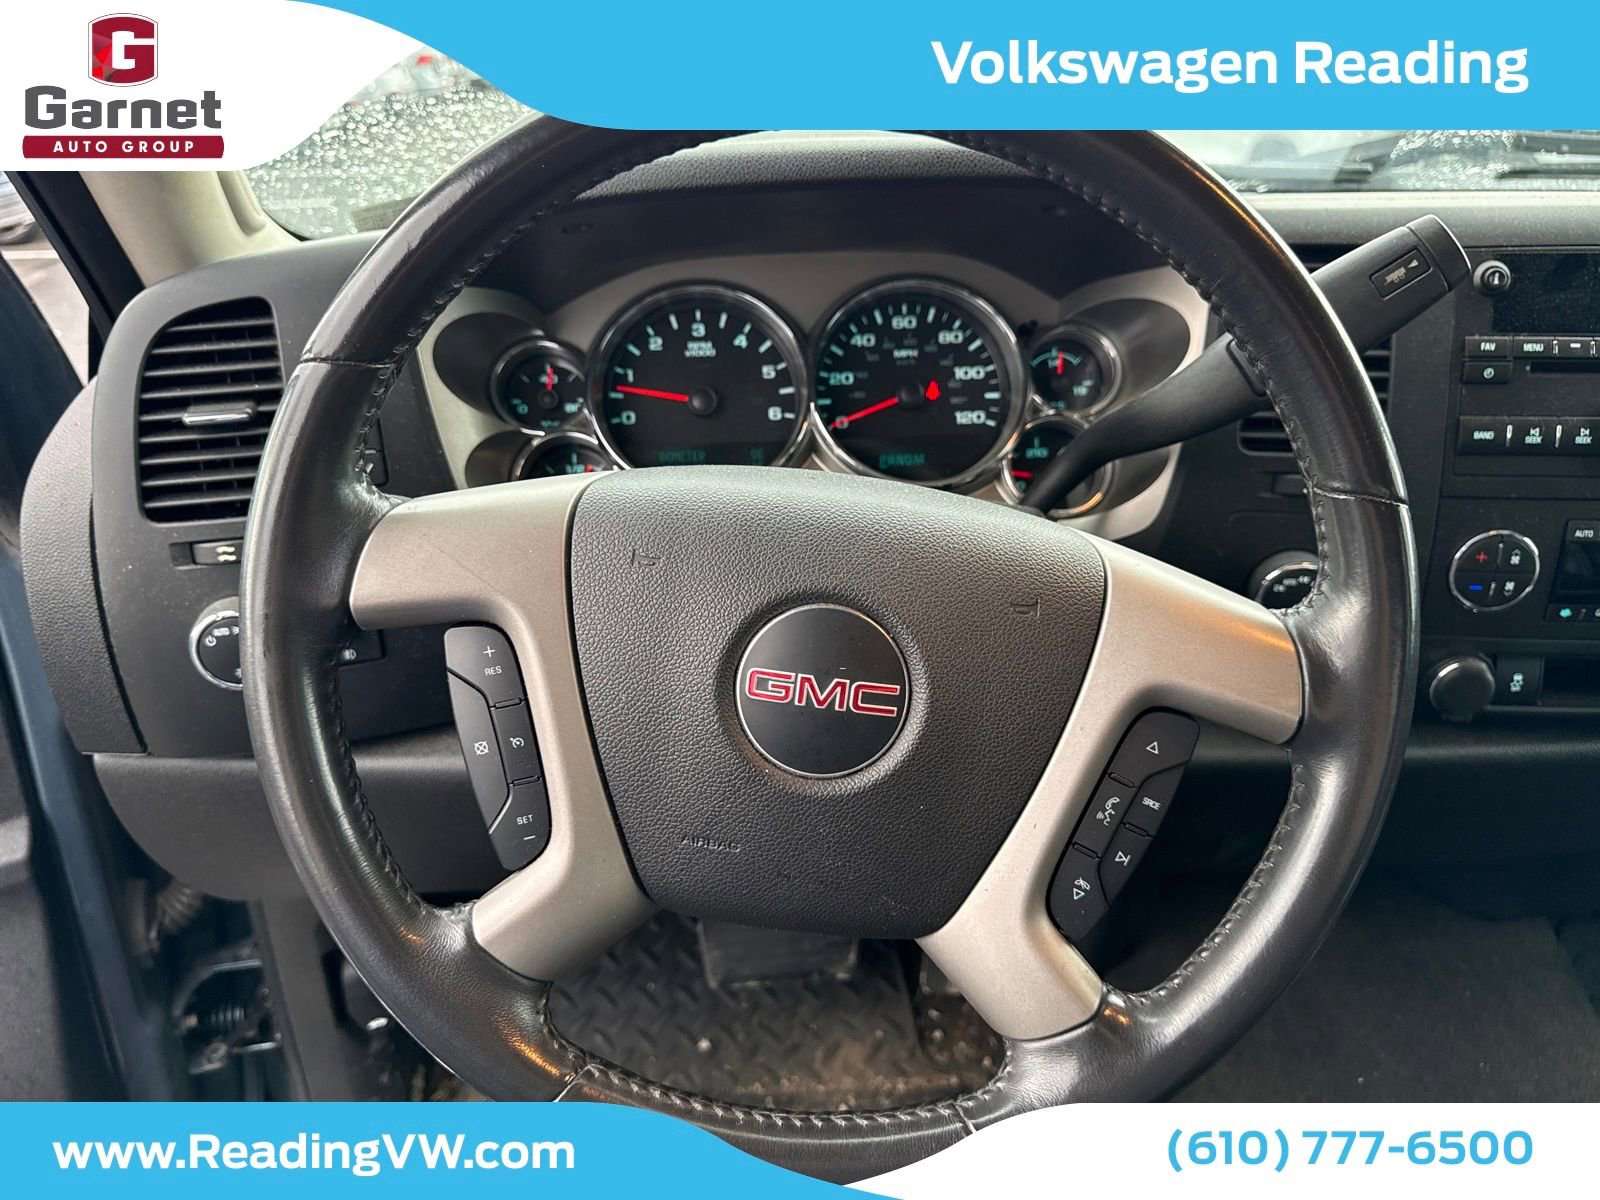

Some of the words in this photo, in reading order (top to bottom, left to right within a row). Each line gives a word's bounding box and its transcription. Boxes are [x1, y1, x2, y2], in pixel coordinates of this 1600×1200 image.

[690, 322, 706, 338] 3
[891, 315, 918, 330] 60
[648, 335, 664, 351] 2
[732, 333, 748, 349] 4
[850, 332, 876, 347] 40
[938, 330, 965, 345] 80
[893, 349, 919, 359] MPH
[1480, 342, 1496, 352] FAV
[1523, 342, 1544, 353] MENU
[626, 367, 635, 383] 1
[761, 364, 777, 380] 5
[829, 372, 855, 386] 20
[953, 366, 987, 381] 100
[620, 411, 636, 425] 0
[767, 406, 783, 422] 6
[954, 411, 986, 426] 120
[1473, 430, 1495, 440] BAND
[1524, 435, 1543, 445] SEEK
[1575, 435, 1593, 445] SEEK
[1574, 529, 1594, 538] AUTO
[484, 666, 503, 677] RES
[745, 667, 901, 718] GMC
[1142, 796, 1161, 811] SRCE
[516, 814, 533, 825] SET
[680, 835, 741, 853] AIRBAG
